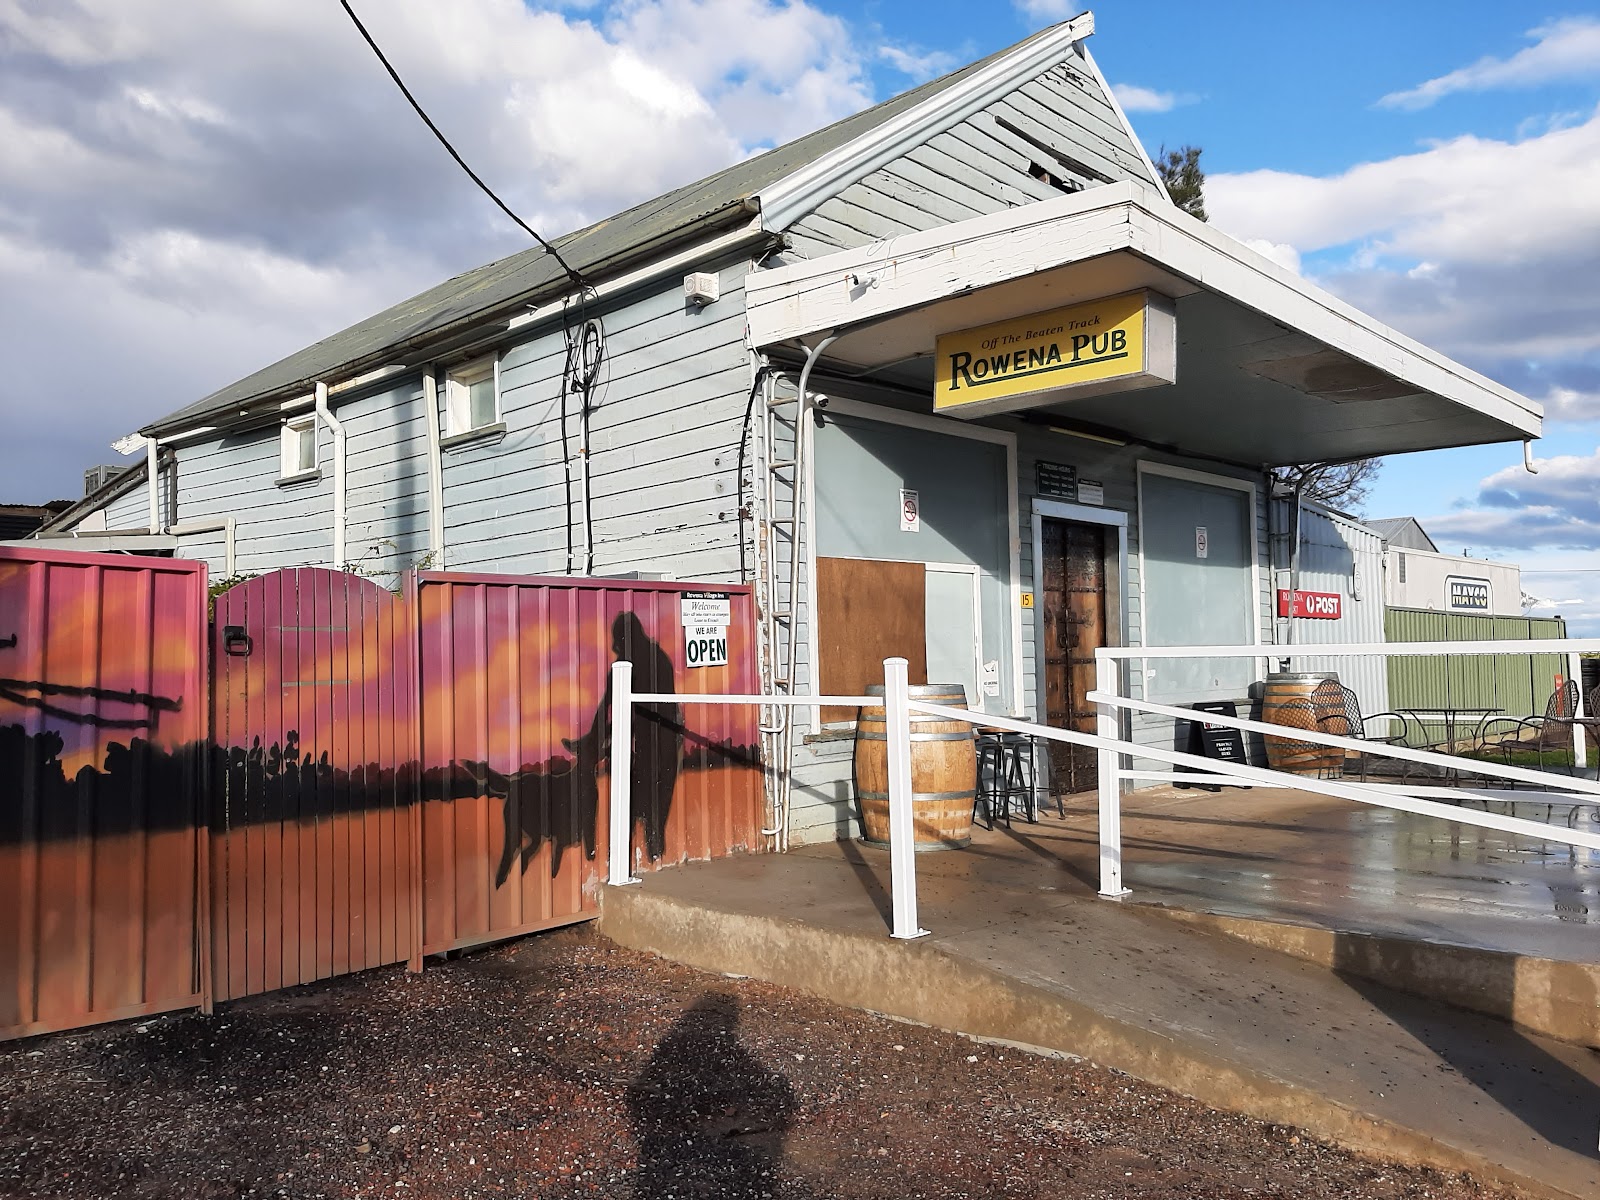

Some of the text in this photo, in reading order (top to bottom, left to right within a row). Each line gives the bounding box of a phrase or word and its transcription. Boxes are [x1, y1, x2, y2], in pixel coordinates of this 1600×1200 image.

[981, 315, 1102, 350] Off The Beaten Track
[948, 329, 1127, 391] ROWENA PUB
[691, 601, 721, 611] Welcome
[1022, 594, 1030, 606] 15
[1315, 597, 1338, 614] POST
[695, 626, 718, 635] WE ARE
[688, 639, 726, 663] OPEN
